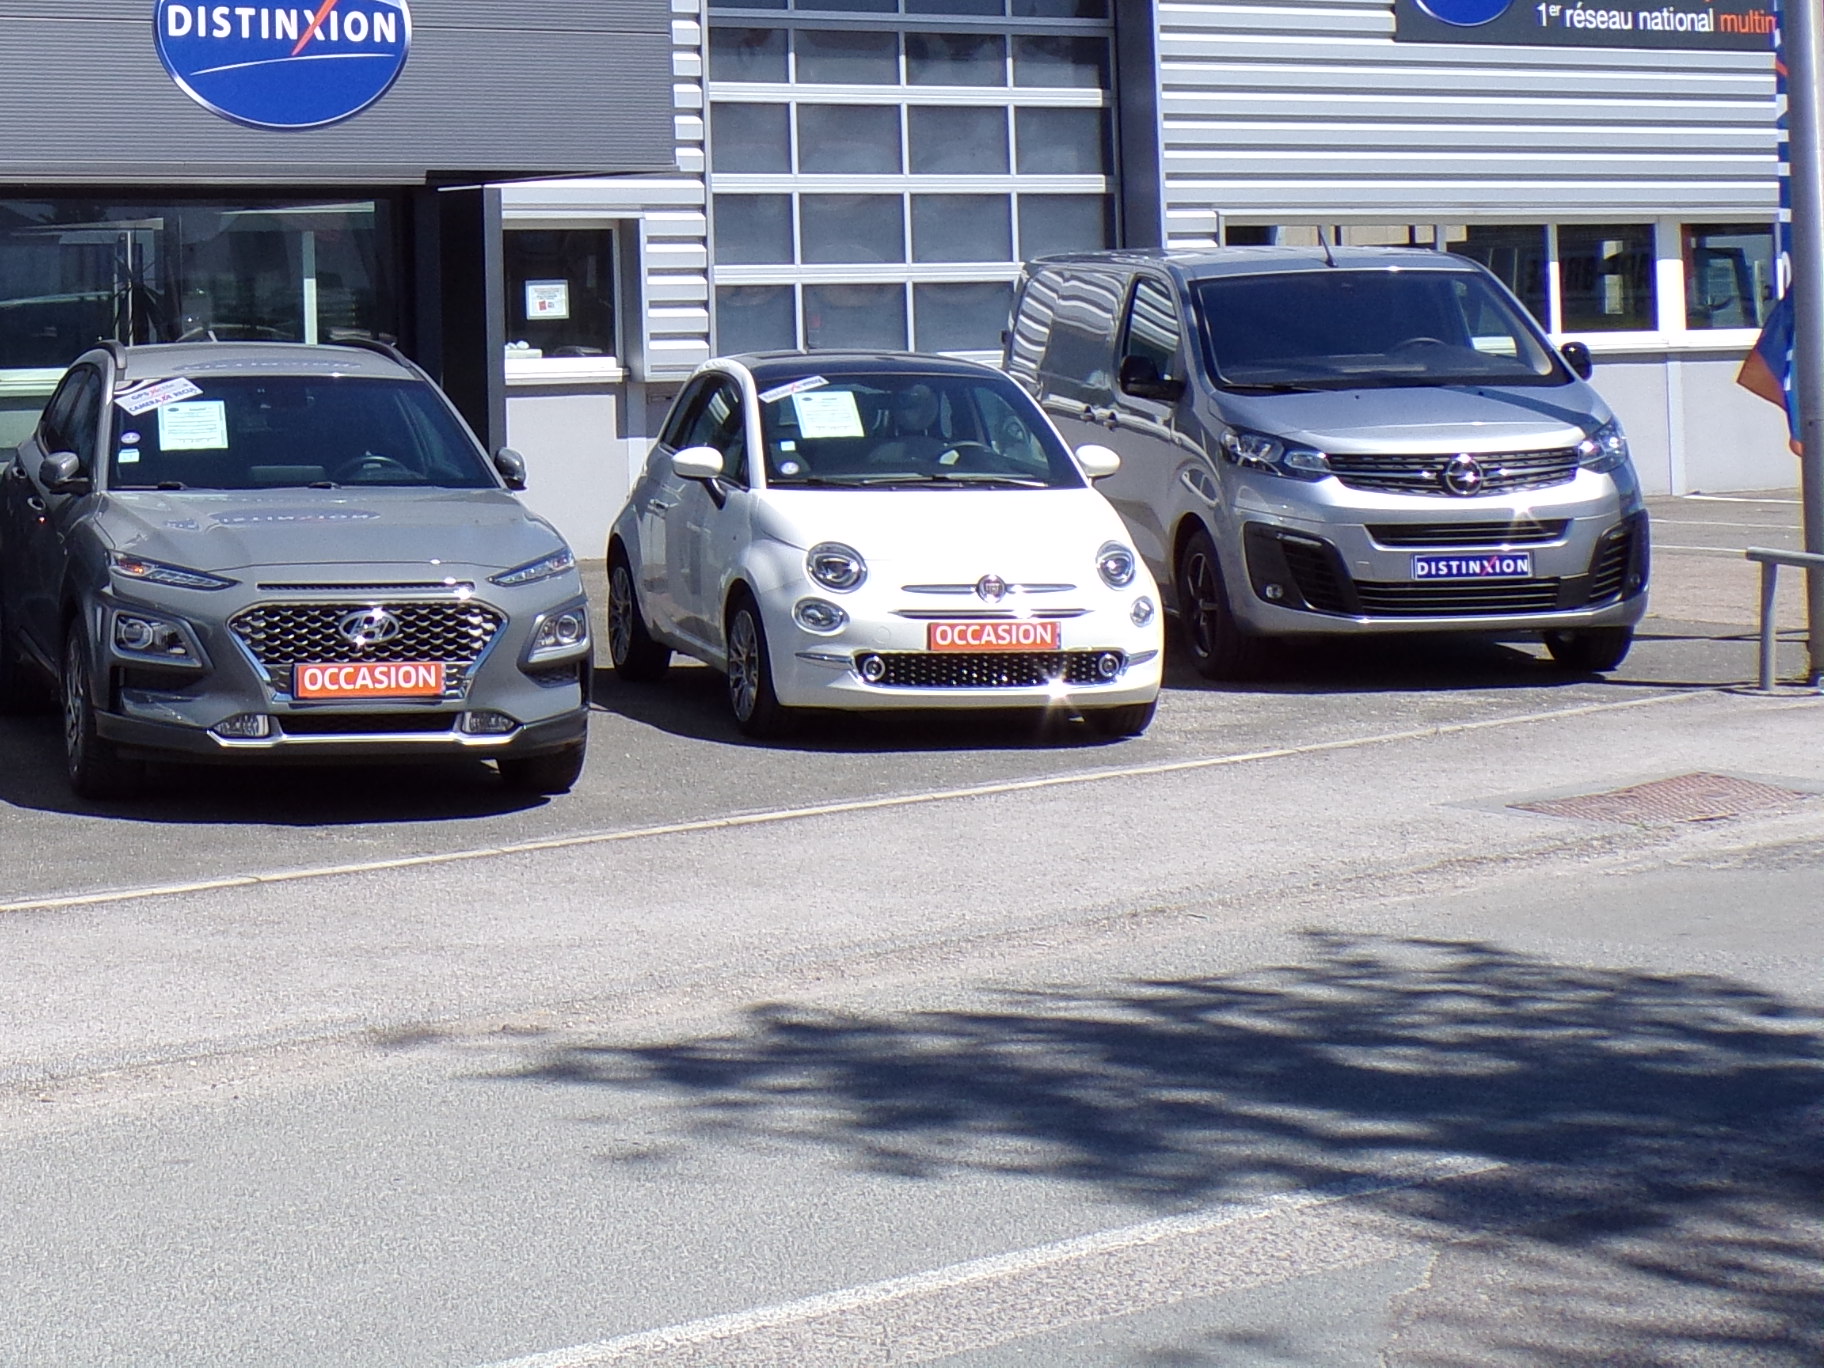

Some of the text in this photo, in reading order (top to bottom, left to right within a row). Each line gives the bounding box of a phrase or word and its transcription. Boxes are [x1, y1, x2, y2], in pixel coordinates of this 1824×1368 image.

[1537, 2, 1562, 27] 1er
[1565, 1, 1633, 30] réseau
[1638, 6, 1715, 32] national
[1417, 556, 1528, 576] DISTINXION
[935, 624, 1052, 646] OCCASION
[304, 665, 437, 691] OCCASION
